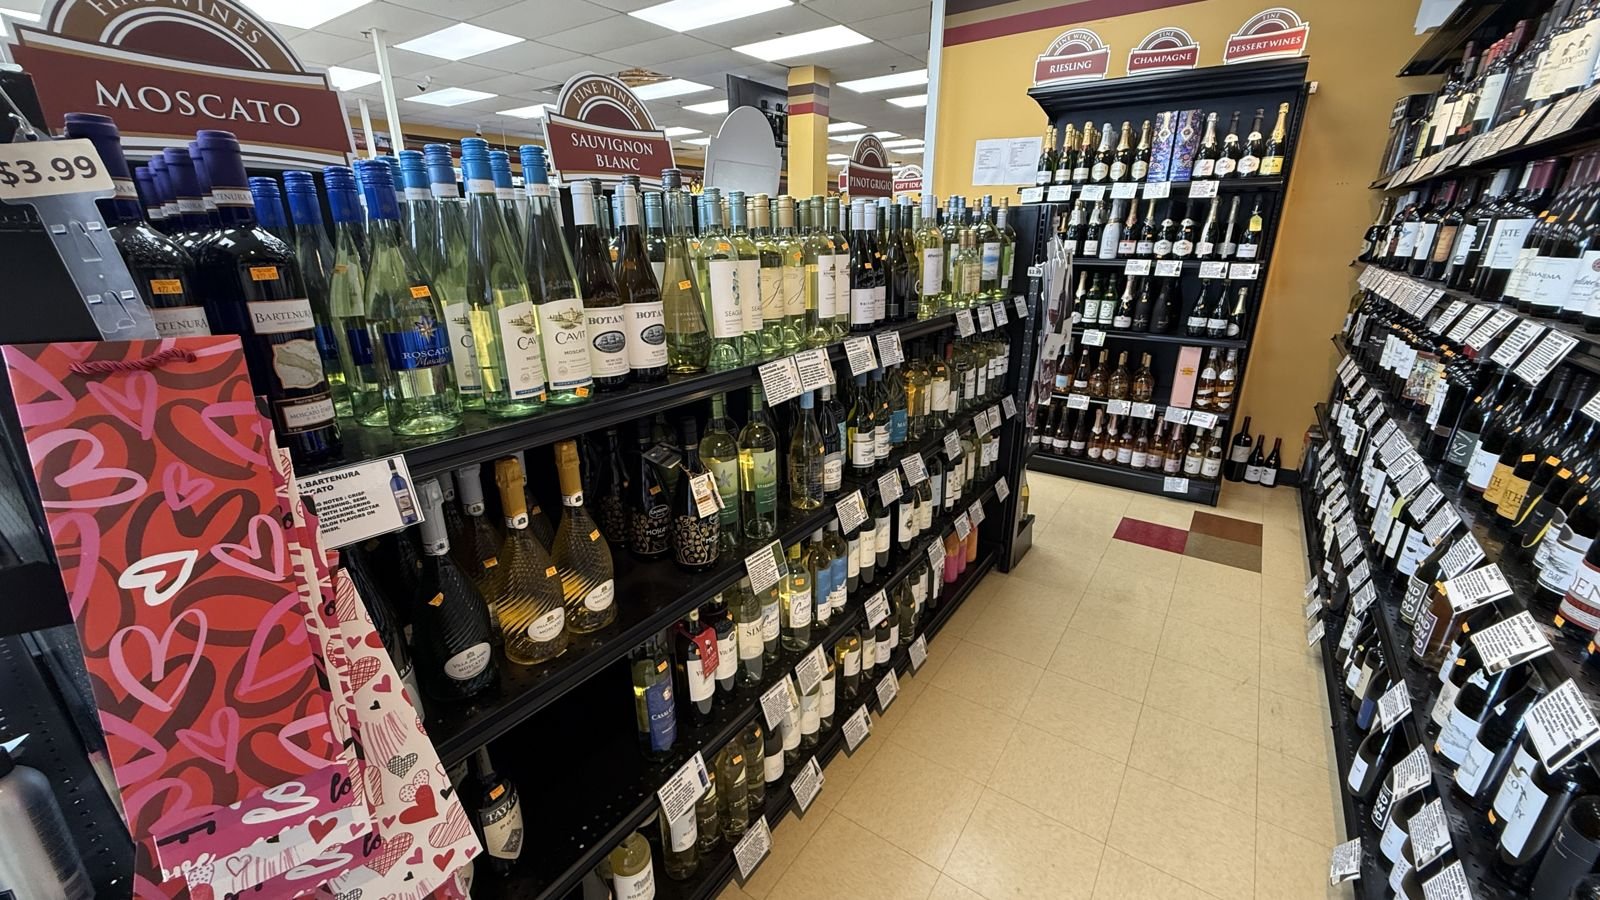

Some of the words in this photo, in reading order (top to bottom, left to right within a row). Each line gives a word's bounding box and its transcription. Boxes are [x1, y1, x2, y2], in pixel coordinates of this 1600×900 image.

[1055, 34, 1071, 49] FINE
[1073, 33, 1094, 45] WINES
[1229, 41, 1268, 54] DESSERT
[1269, 36, 1301, 48] WINES
[1134, 52, 1193, 65] CHAMPAGNE
[1050, 60, 1092, 74] RIESLING
[95, 79, 301, 127] MOSCATO
[573, 82, 599, 104] FINE
[601, 82, 638, 114] WINES
[571, 133, 653, 155] SAUVIGNON
[596, 154, 640, 170] BLANC
[0, 156, 97, 187] $3.99
[849, 176, 870, 189] PINOT
[870, 178, 892, 191] GRIGIO
[402, 347, 450, 360] ROSCATO
[297, 470, 361, 490] 1.BARTENURA
[322, 496, 344, 507] NOTES
[347, 491, 365, 499] CRISP
[320, 511, 357, 523] TANGERINE,
[357, 503, 380, 512] NECTAR
[321, 509, 338, 517] WITH
[339, 500, 371, 513] LINGERING
[339, 515, 367, 525] FLAVORS
